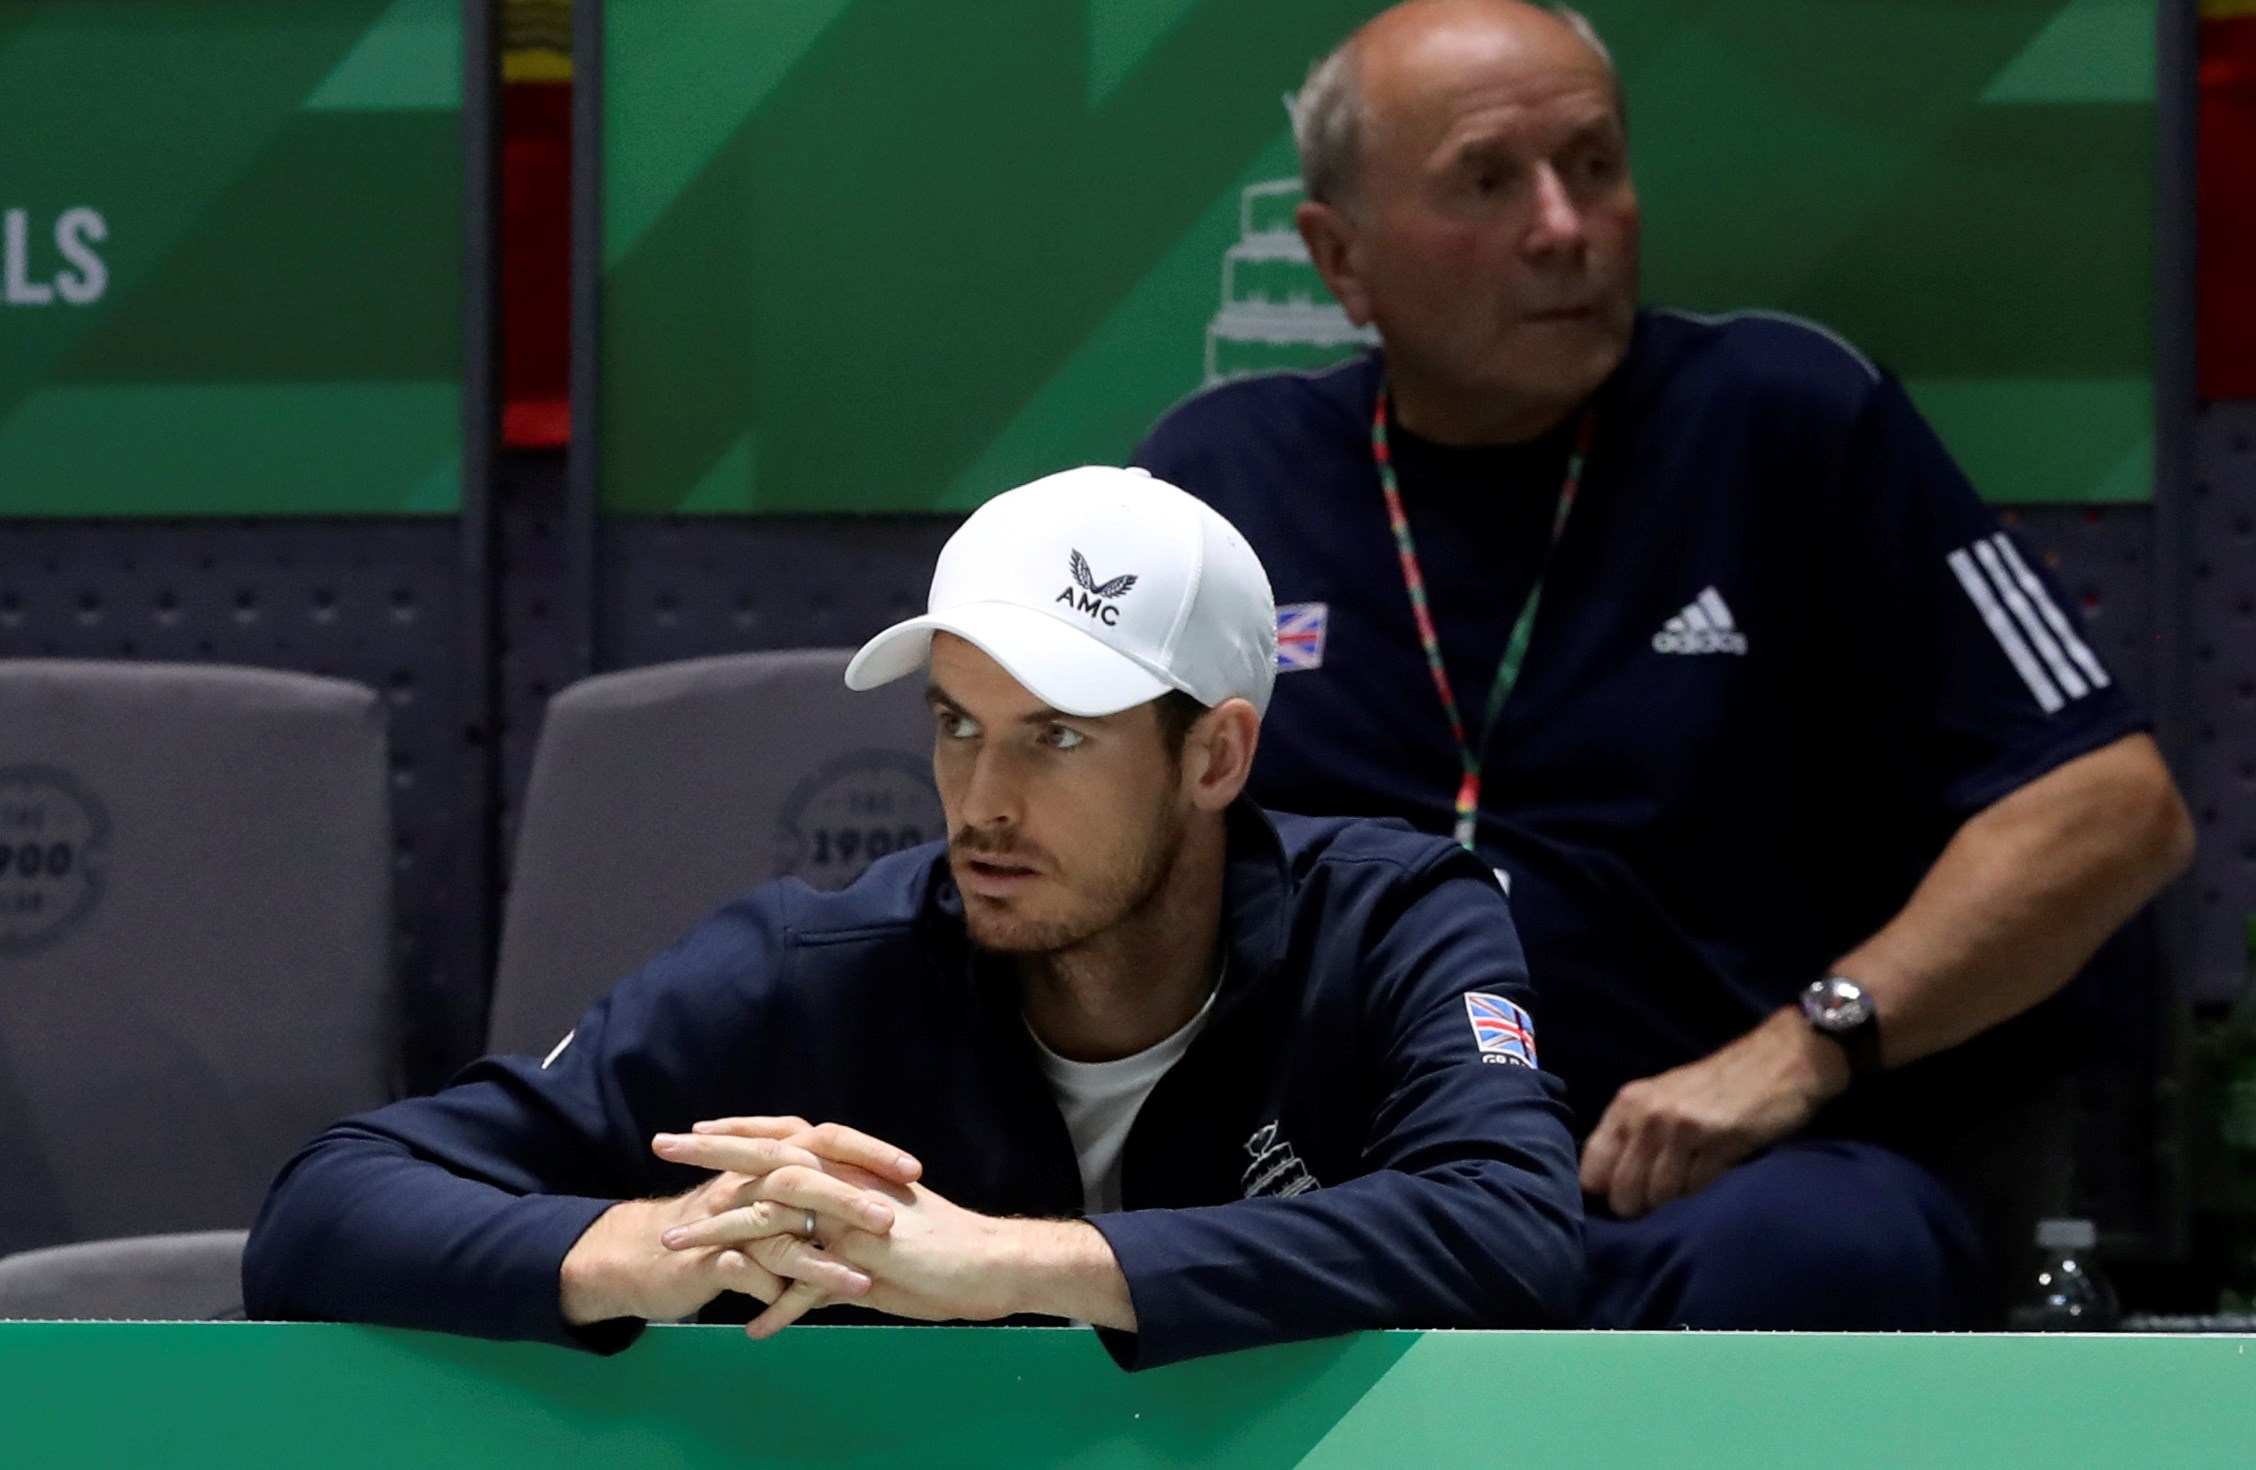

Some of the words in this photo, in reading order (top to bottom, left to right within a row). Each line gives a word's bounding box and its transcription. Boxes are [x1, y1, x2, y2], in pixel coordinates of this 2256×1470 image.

[0, 206, 109, 304] LS
[1056, 586, 1120, 626] AMC
[1651, 631, 1748, 655] adidas
